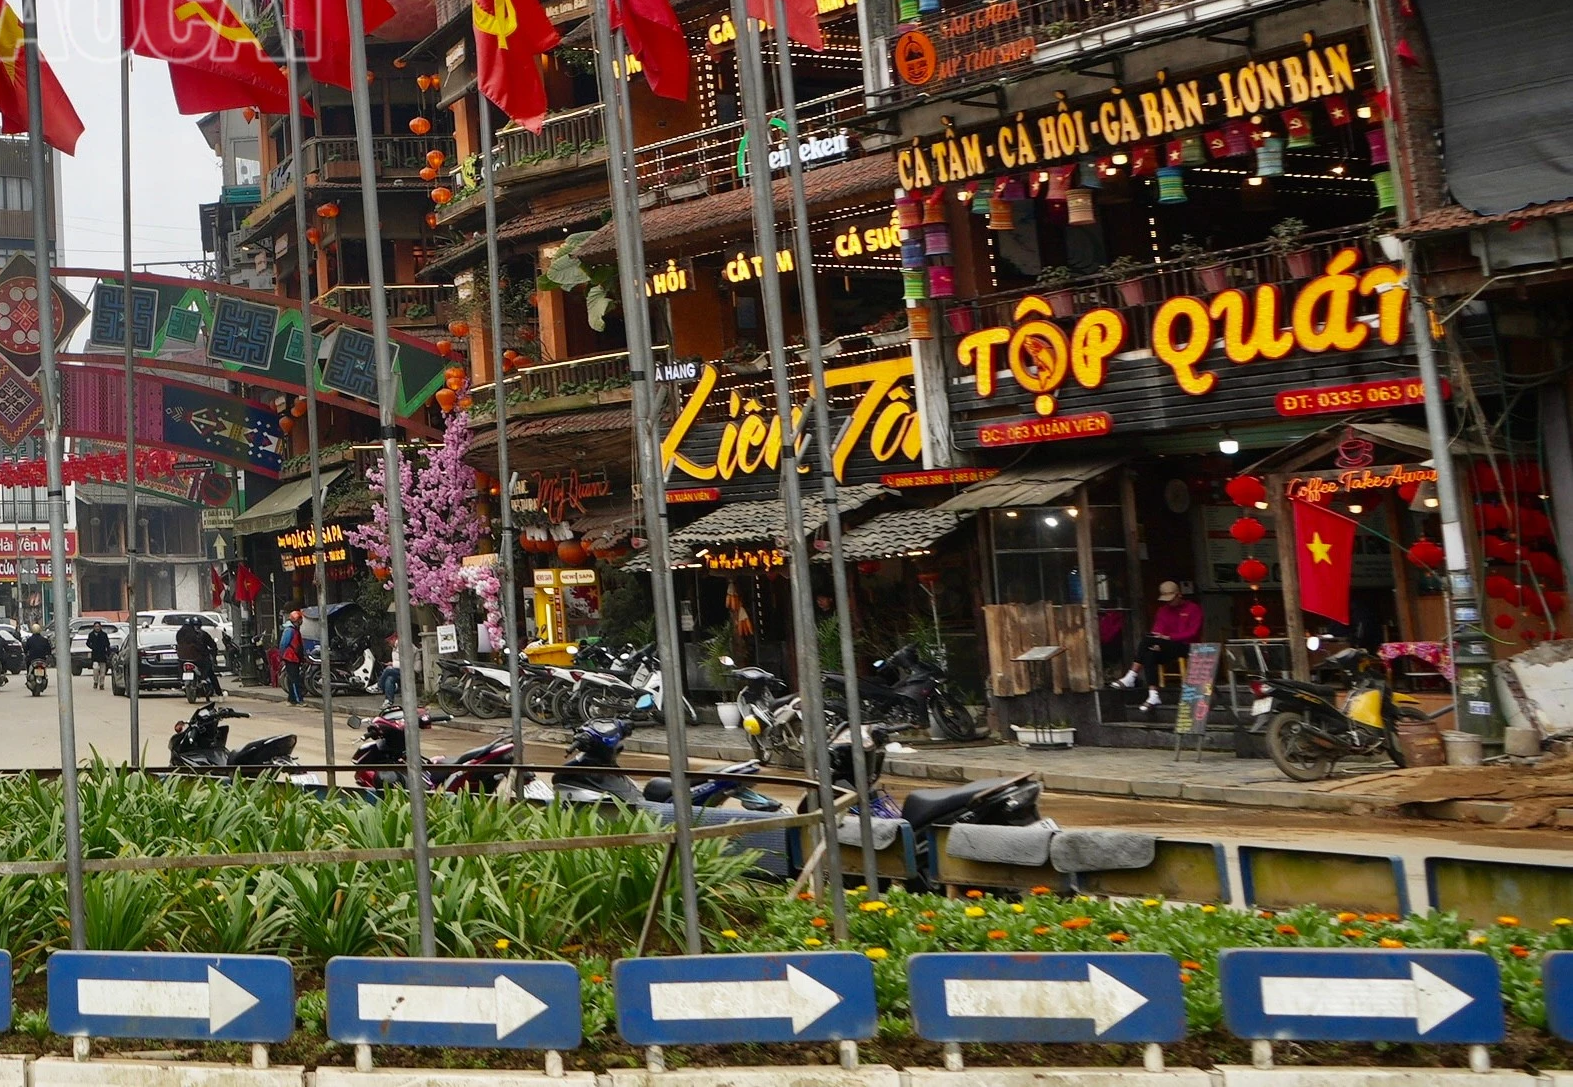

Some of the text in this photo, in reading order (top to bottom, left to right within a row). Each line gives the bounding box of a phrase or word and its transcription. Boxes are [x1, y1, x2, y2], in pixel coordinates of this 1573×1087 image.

[897, 130, 930, 191] CÁ
[931, 115, 986, 183] TẦM
[998, 112, 1038, 169] CÁ
[1040, 90, 1090, 159] HỒI
[1100, 86, 1139, 146] GÀ
[1140, 69, 1205, 137] BẢN
[1279, 31, 1356, 104] BẢN
[769, 130, 850, 170] eieken
[835, 210, 903, 258] CÁ SUỐ
[726, 249, 794, 283] CÁ TM
[664, 360, 697, 381] HÀNG
[1282, 394, 1315, 411] ĐT:
[1317, 389, 1364, 408] 0335
[1366, 384, 1403, 402] 063
[1031, 419, 1071, 438] XUÂN
[1288, 477, 1340, 502] Coffee
[1339, 469, 1384, 492] Take
[41, 537, 70, 552] Mt
[40, 560, 53, 577] TIỆ
